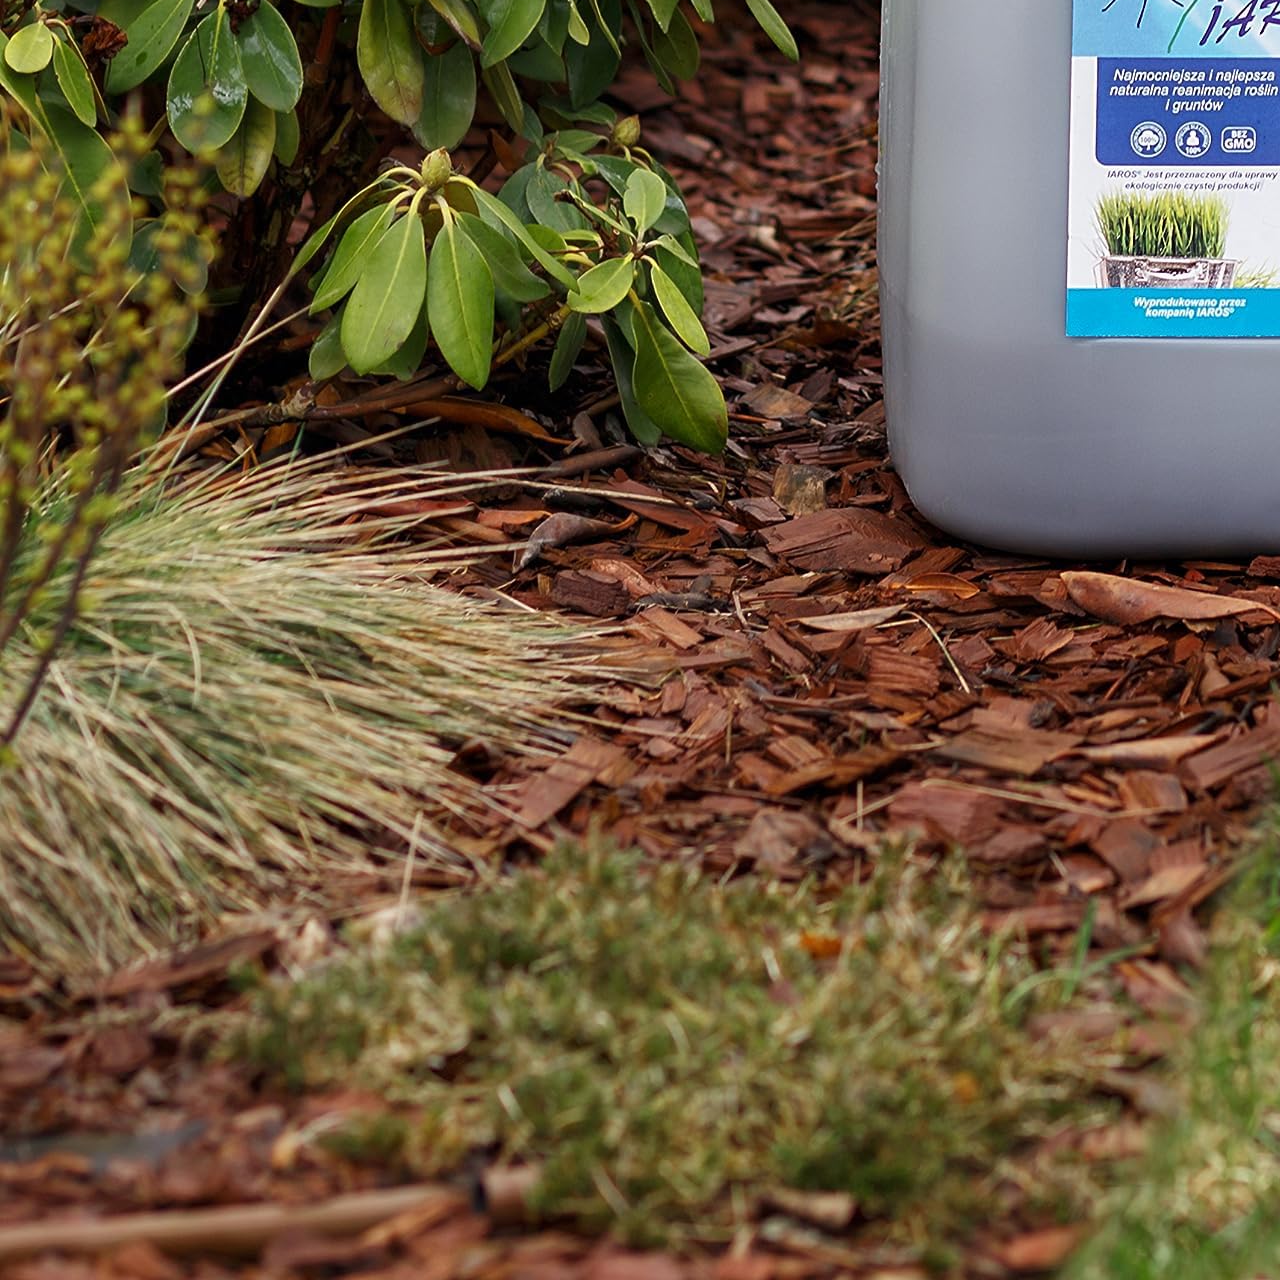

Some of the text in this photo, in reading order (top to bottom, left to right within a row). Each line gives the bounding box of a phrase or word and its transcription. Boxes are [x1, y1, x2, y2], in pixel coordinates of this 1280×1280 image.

[1113, 69, 1275, 84] Najmocniejsza i najlepsza
[1109, 83, 1279, 99] naturalna reanimacja roślin
[1165, 99, 1224, 114] i gruntów
[1231, 130, 1248, 139] BEZ
[1224, 138, 1254, 150] GMO
[1165, 172, 1226, 180] przeznaczony
[1228, 170, 1242, 178] dla
[1125, 182, 1260, 191] ekologicznie czystej produkcji
[1134, 297, 1247, 309] Wyprodukowano przez
[1145, 307, 1195, 319] kompanię
